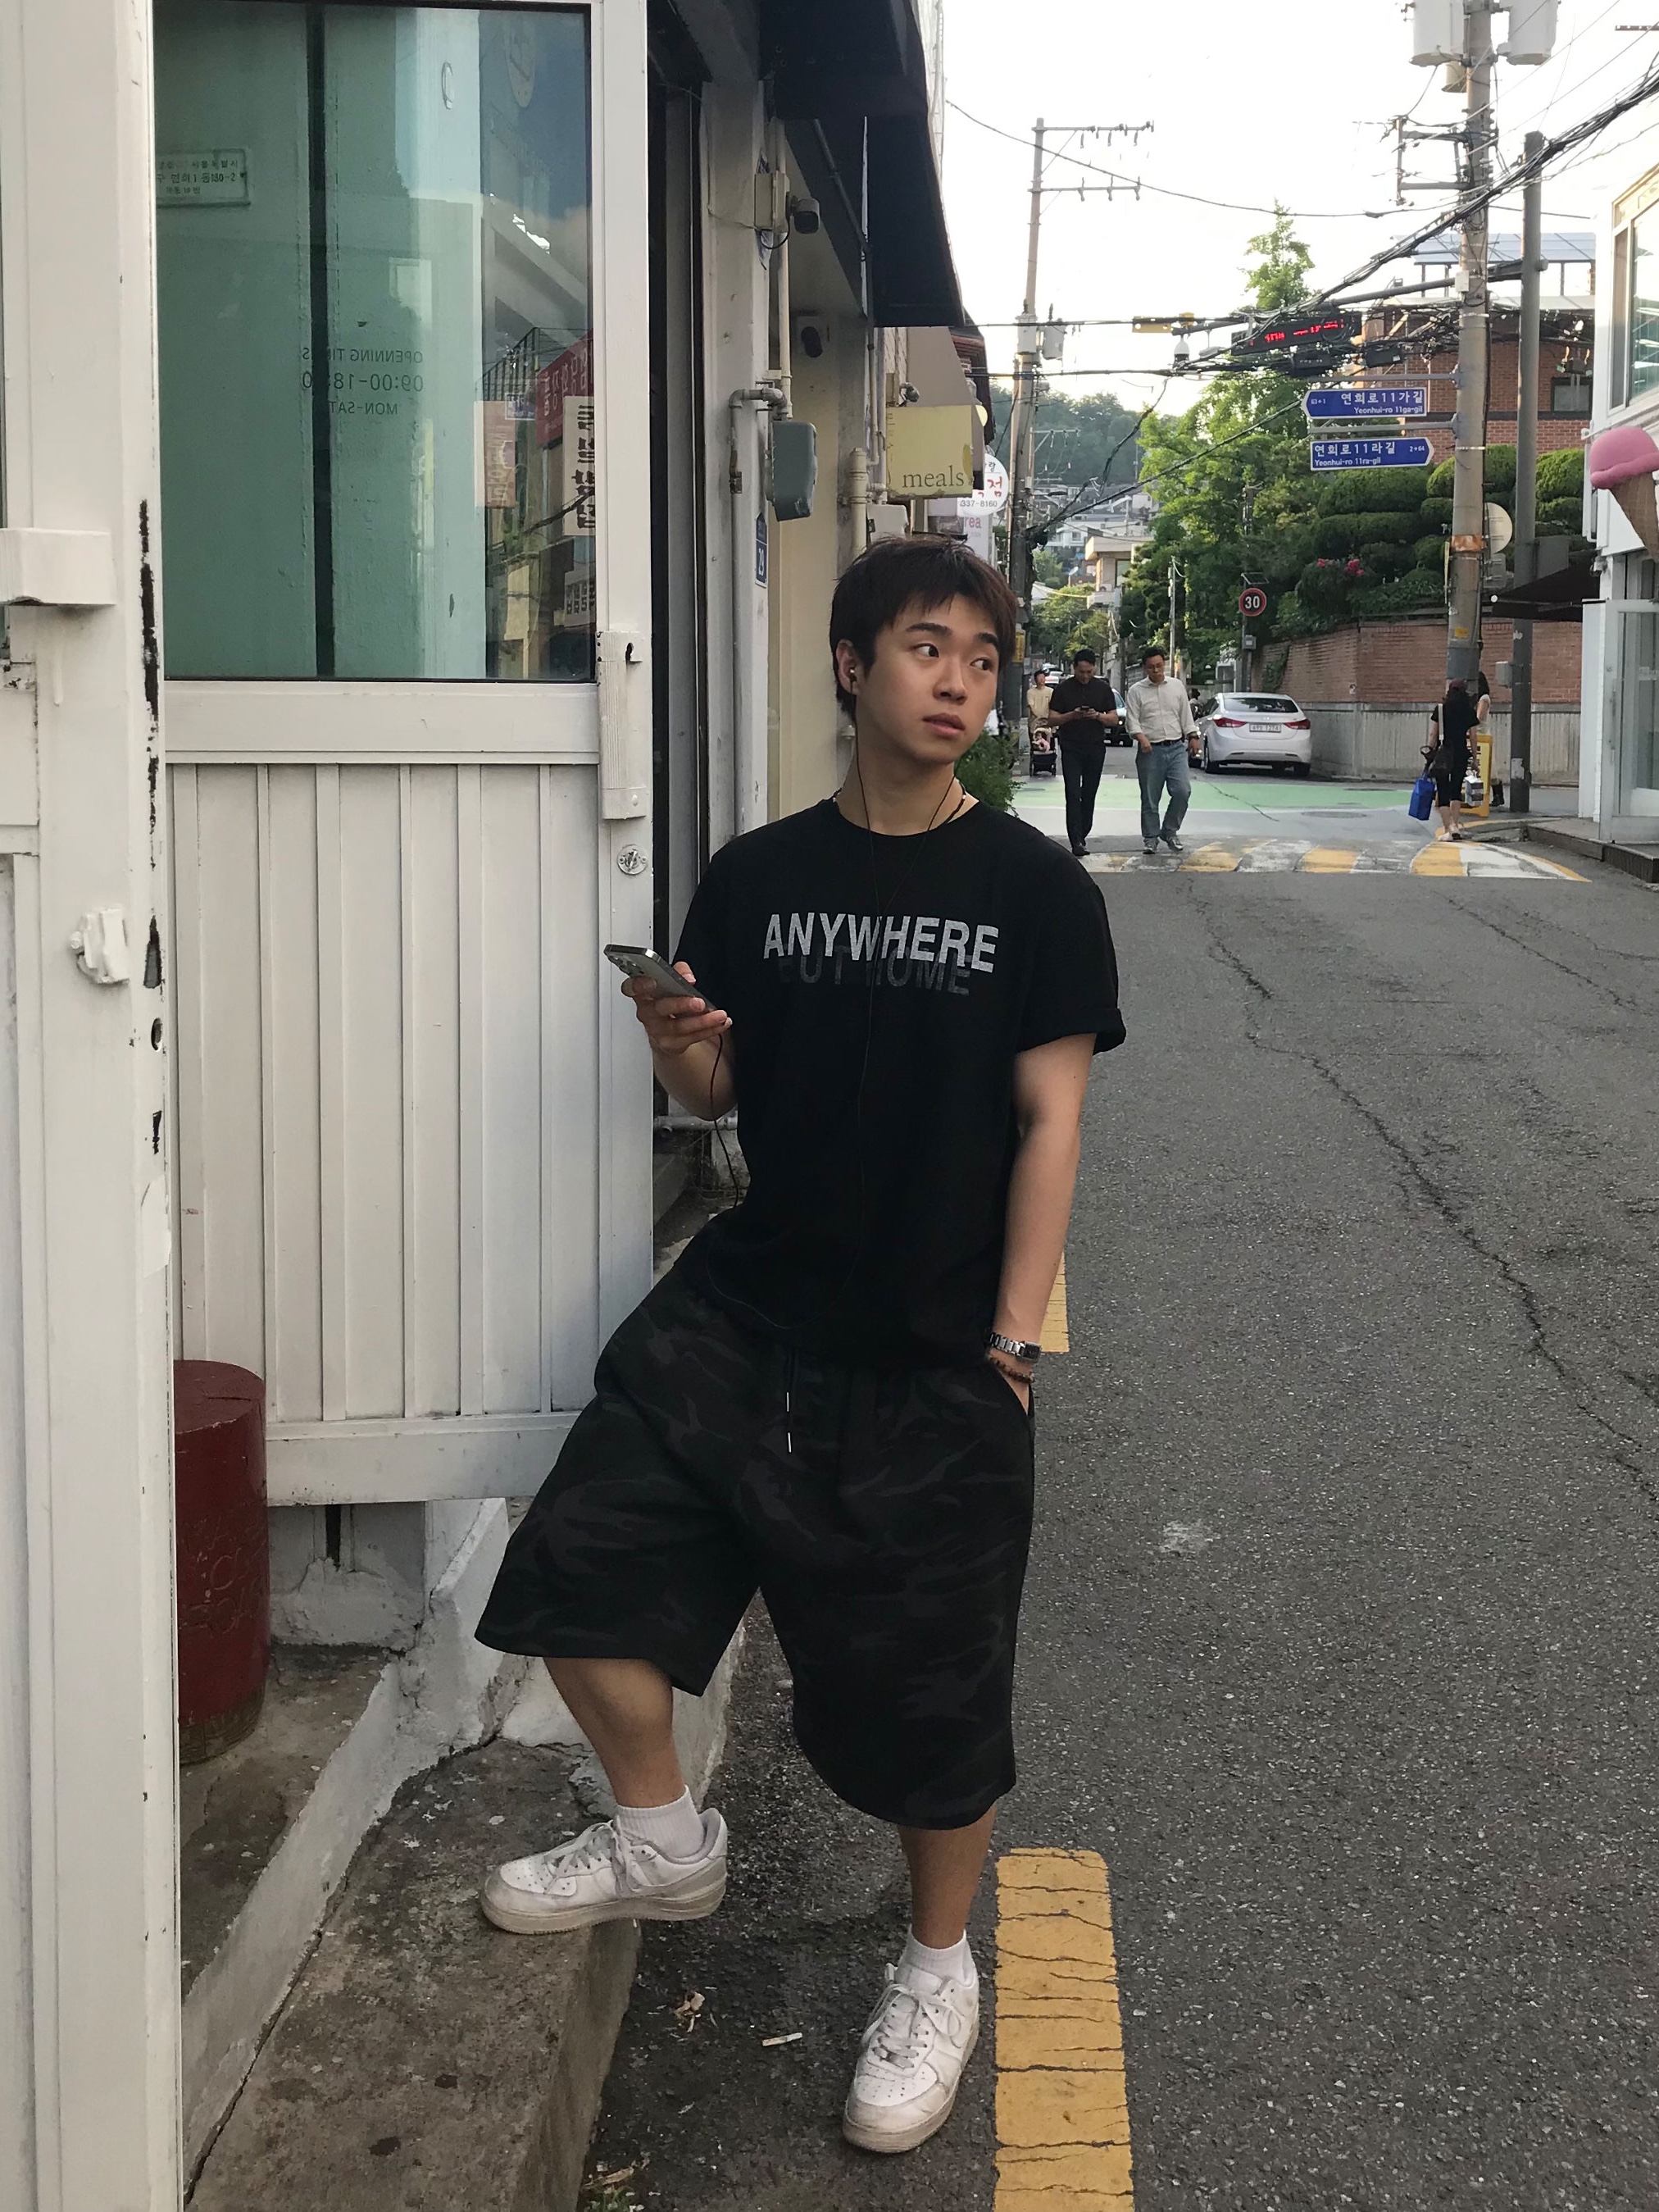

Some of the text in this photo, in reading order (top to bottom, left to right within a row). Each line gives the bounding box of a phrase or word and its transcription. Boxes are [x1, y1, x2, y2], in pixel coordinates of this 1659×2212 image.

[1341, 391, 1423, 405] 연희로11가길
[1314, 441, 1395, 457] 연희로11라길
[902, 465, 964, 488] meals
[1245, 596, 1260, 608] 30
[764, 913, 999, 973] ANYWHERE
[866, 945, 972, 996] HOME
